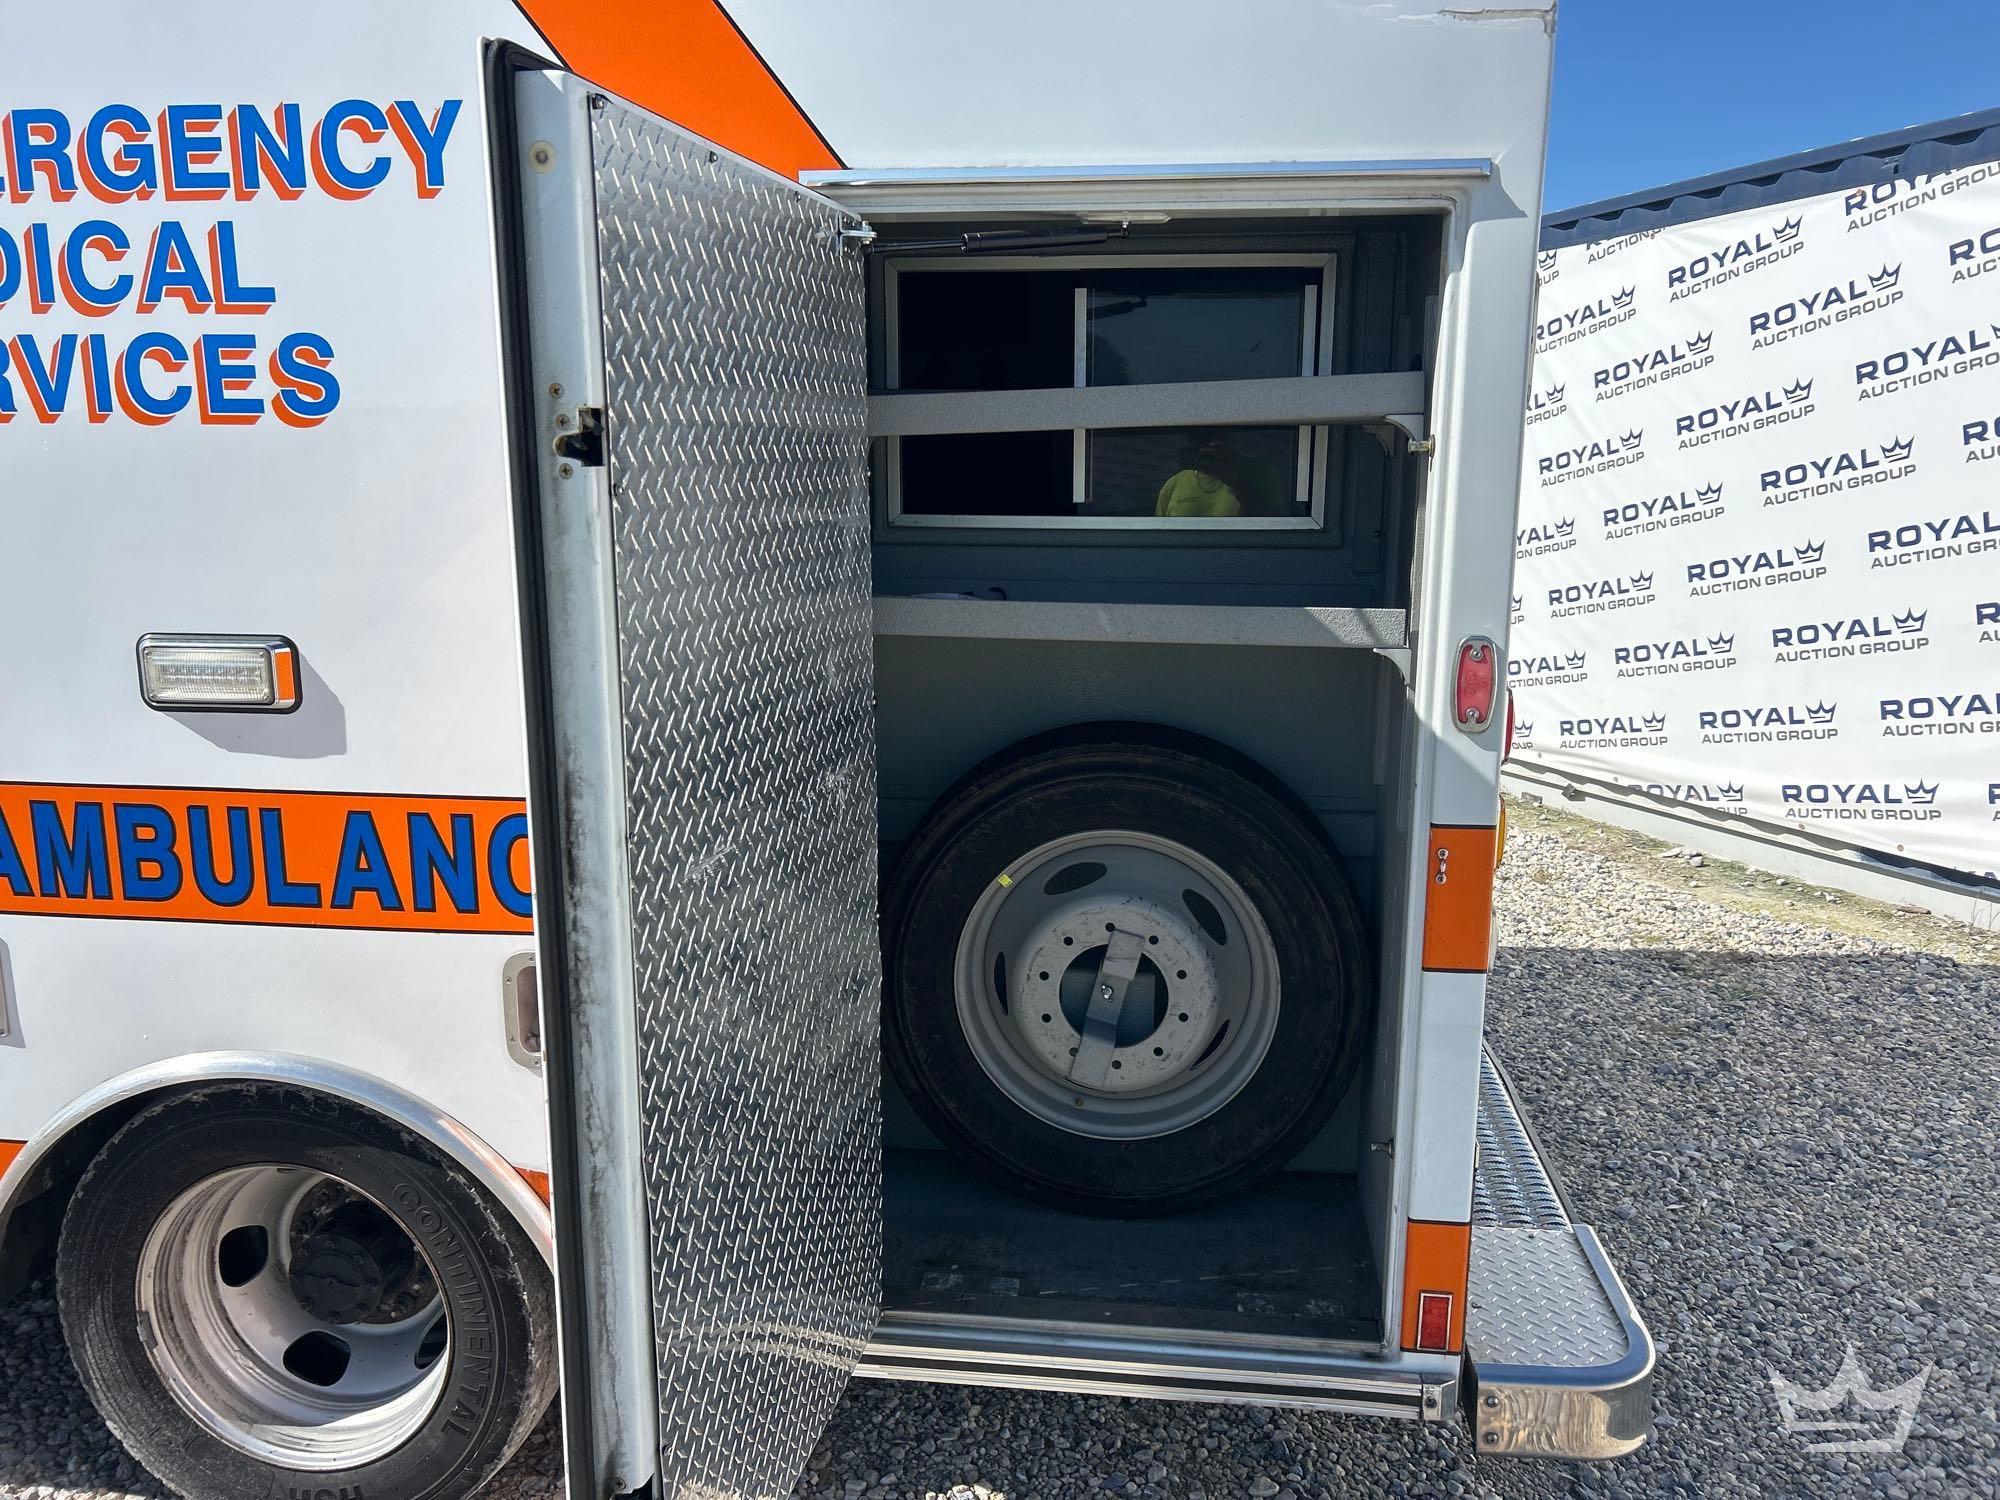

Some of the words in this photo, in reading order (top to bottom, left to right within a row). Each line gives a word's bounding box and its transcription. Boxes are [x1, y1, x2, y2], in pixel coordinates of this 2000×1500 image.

[0, 99, 463, 203] RGENCY
[1847, 188, 1937, 233] AUCTION
[1588, 230, 1650, 264] AUCTION
[1668, 233, 1772, 288] ROYAL
[1670, 267, 1740, 302] AUCTION
[1743, 241, 1804, 274] GROUP
[1952, 257, 2000, 283] AUC
[1588, 308, 1637, 334] GROUP
[1750, 280, 1868, 335] ROYAL
[1752, 315, 1832, 351] AUCTION
[1835, 290, 1904, 323] GROUP
[1594, 344, 1686, 389] ROYAL
[1855, 329, 1991, 385] ROYAL
[0, 332, 340, 429] VICES
[1595, 373, 1657, 402] AUCTION
[1660, 355, 1715, 381] GROUP
[1858, 366, 1949, 401] AUCTION
[1526, 404, 1567, 425] GROUP
[1676, 391, 1783, 436] ROYAL
[1678, 422, 1750, 450] AUCTION
[1753, 404, 1815, 430] GROUP
[1538, 438, 1620, 475] ROYAL
[1541, 465, 1595, 488] AUCTION
[1597, 451, 1645, 472] GROUP
[1760, 448, 1880, 492] ROYAL
[1763, 480, 1843, 508] AUCTION
[1847, 464, 1917, 489] GROUP
[1603, 491, 1696, 527] ROYAL
[1605, 518, 1667, 540] AUCTION
[1670, 506, 1725, 527] GROUP
[1535, 538, 1577, 556] GROUP
[1868, 511, 2000, 553] ROYAL
[1687, 549, 1794, 583] ROYAL
[1870, 543, 1962, 569] AUCTION
[1967, 538, 2000, 554] GR
[1548, 578, 1630, 606] ROYAL
[1689, 577, 1761, 597] AUCTION
[1765, 566, 1827, 585] GROUP
[1551, 602, 1605, 618] AUCTION
[1608, 594, 1656, 610] GROUP
[1772, 616, 1892, 648] ROYAL
[1614, 639, 1707, 664] ROYAL
[1774, 645, 1855, 663] AUCTION
[1859, 637, 1930, 655] GROUP
[1545, 672, 1588, 685] GROUP
[1617, 662, 1679, 678] AUCTION
[1682, 657, 1737, 671] GROUP
[1699, 706, 1806, 730] ROYAL
[1880, 693, 2000, 720] ROYA
[1559, 738, 1618, 749] AUCTION
[1620, 736, 1668, 747] GROUP
[1560, 716, 1642, 736] ROYAL
[1701, 730, 1772, 744] AUCTION
[1776, 728, 1839, 741] GROUP
[1882, 721, 1974, 737] AUCTION
[1782, 784, 1903, 804] ROYAL
[1785, 808, 1867, 820] AUCTION
[1871, 809, 1942, 821] GROUP
[393, 1183, 493, 1440] CONTINENTAL
